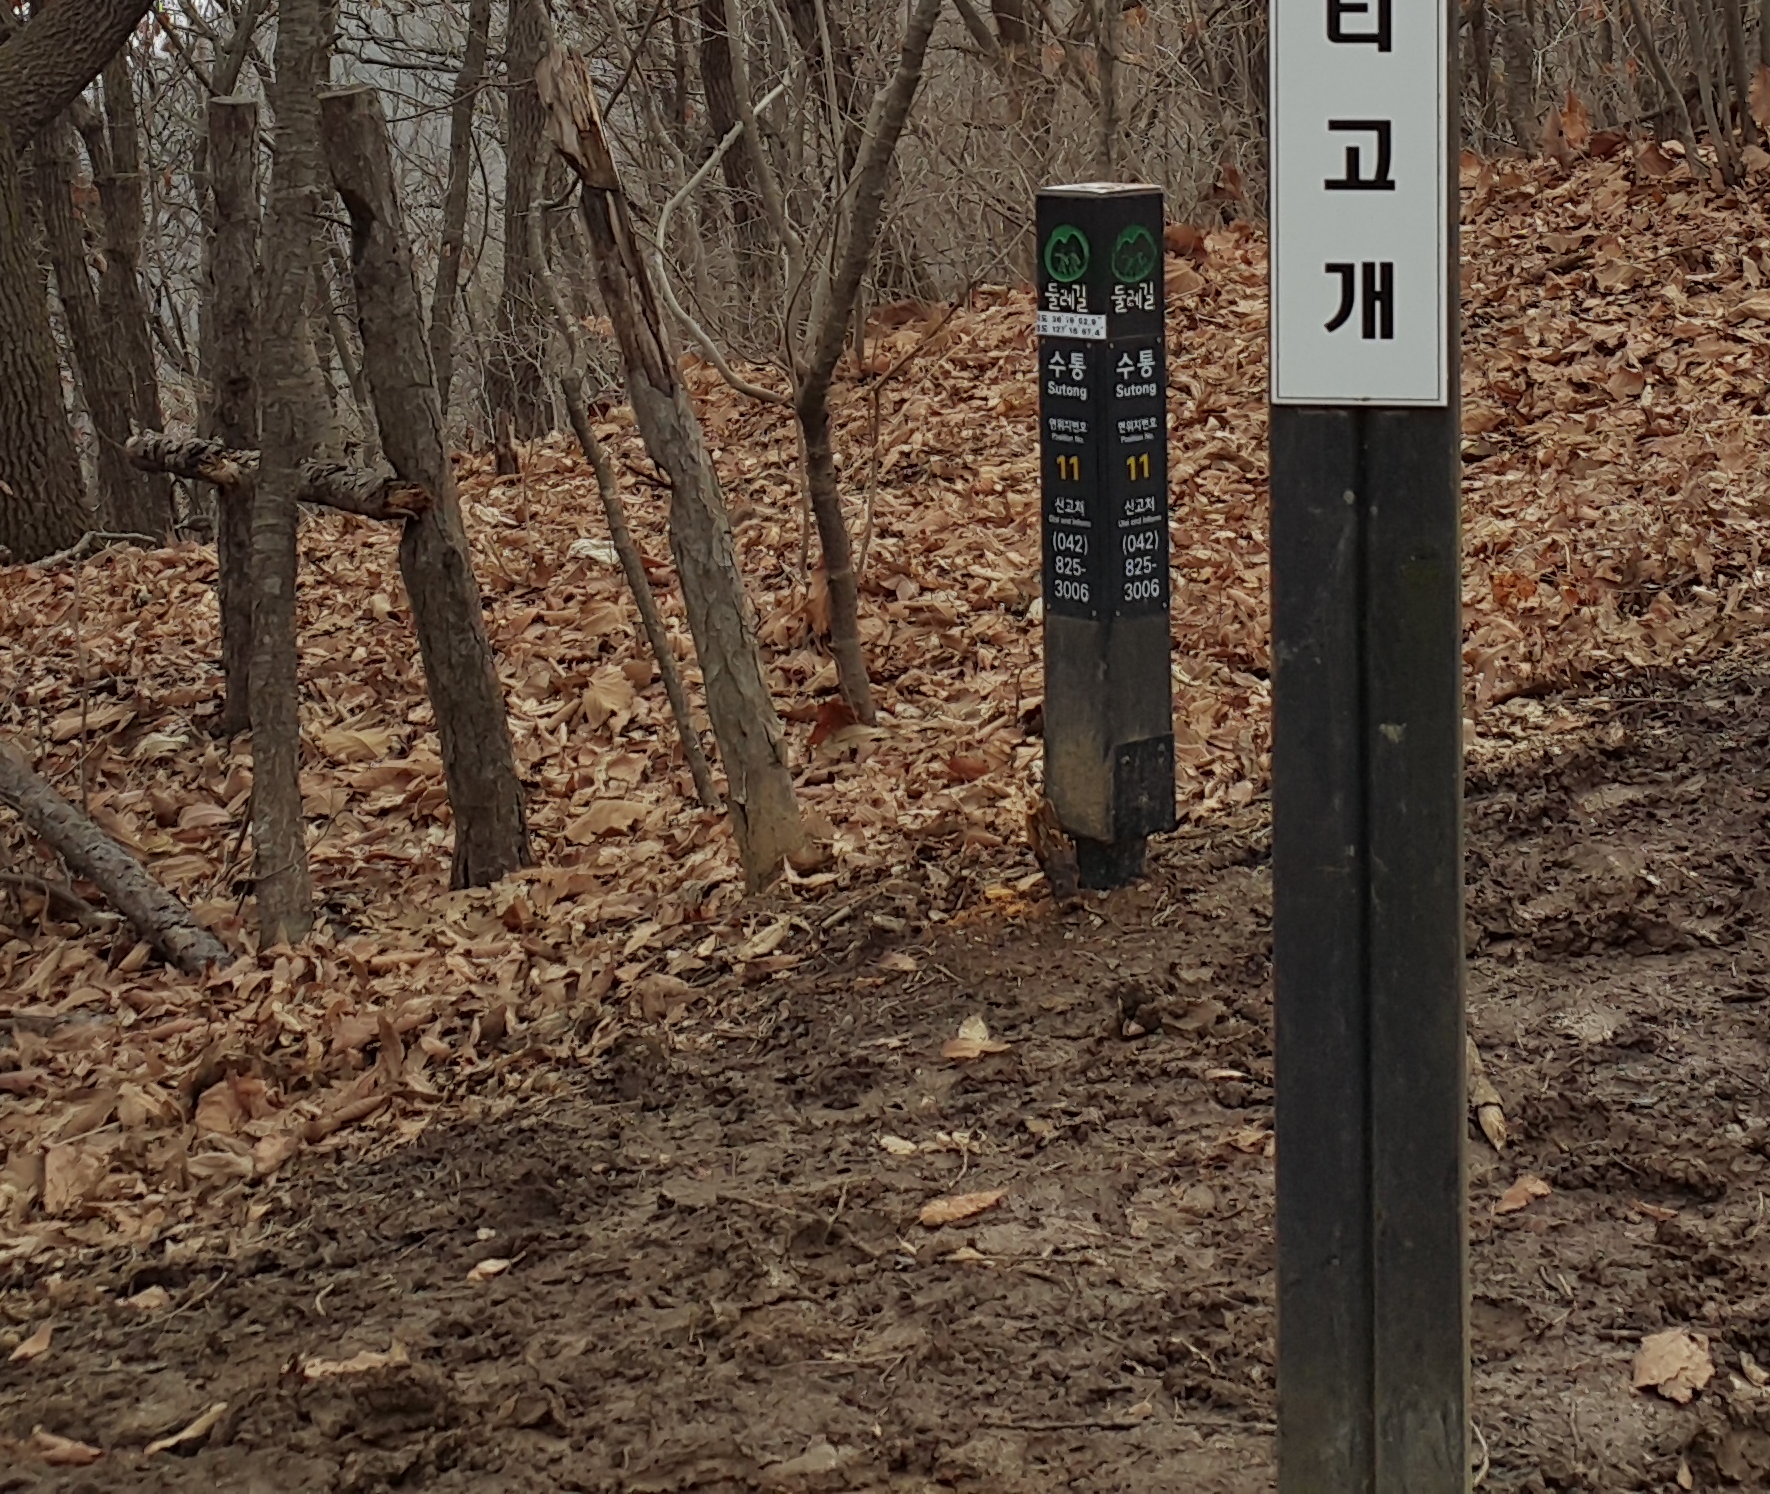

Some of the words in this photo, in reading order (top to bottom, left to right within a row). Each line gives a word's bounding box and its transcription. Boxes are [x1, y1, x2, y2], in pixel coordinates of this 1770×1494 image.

[1044, 282, 1089, 313] 둘레길
[1110, 281, 1156, 314] 둘레길
[1048, 350, 1087, 381] 수통
[1115, 349, 1156, 380] 수통
[1047, 381, 1088, 401] Sutong
[1115, 383, 1157, 398] Sutong
[1056, 454, 1080, 481] 11
[1126, 452, 1150, 481] 11
[1052, 531, 1088, 556] (042)
[1122, 529, 1159, 556] (042)
[1055, 555, 1087, 576] 825-
[1125, 555, 1158, 577] 825-
[1054, 579, 1090, 603] 3006
[1123, 578, 1160, 602] 3006
